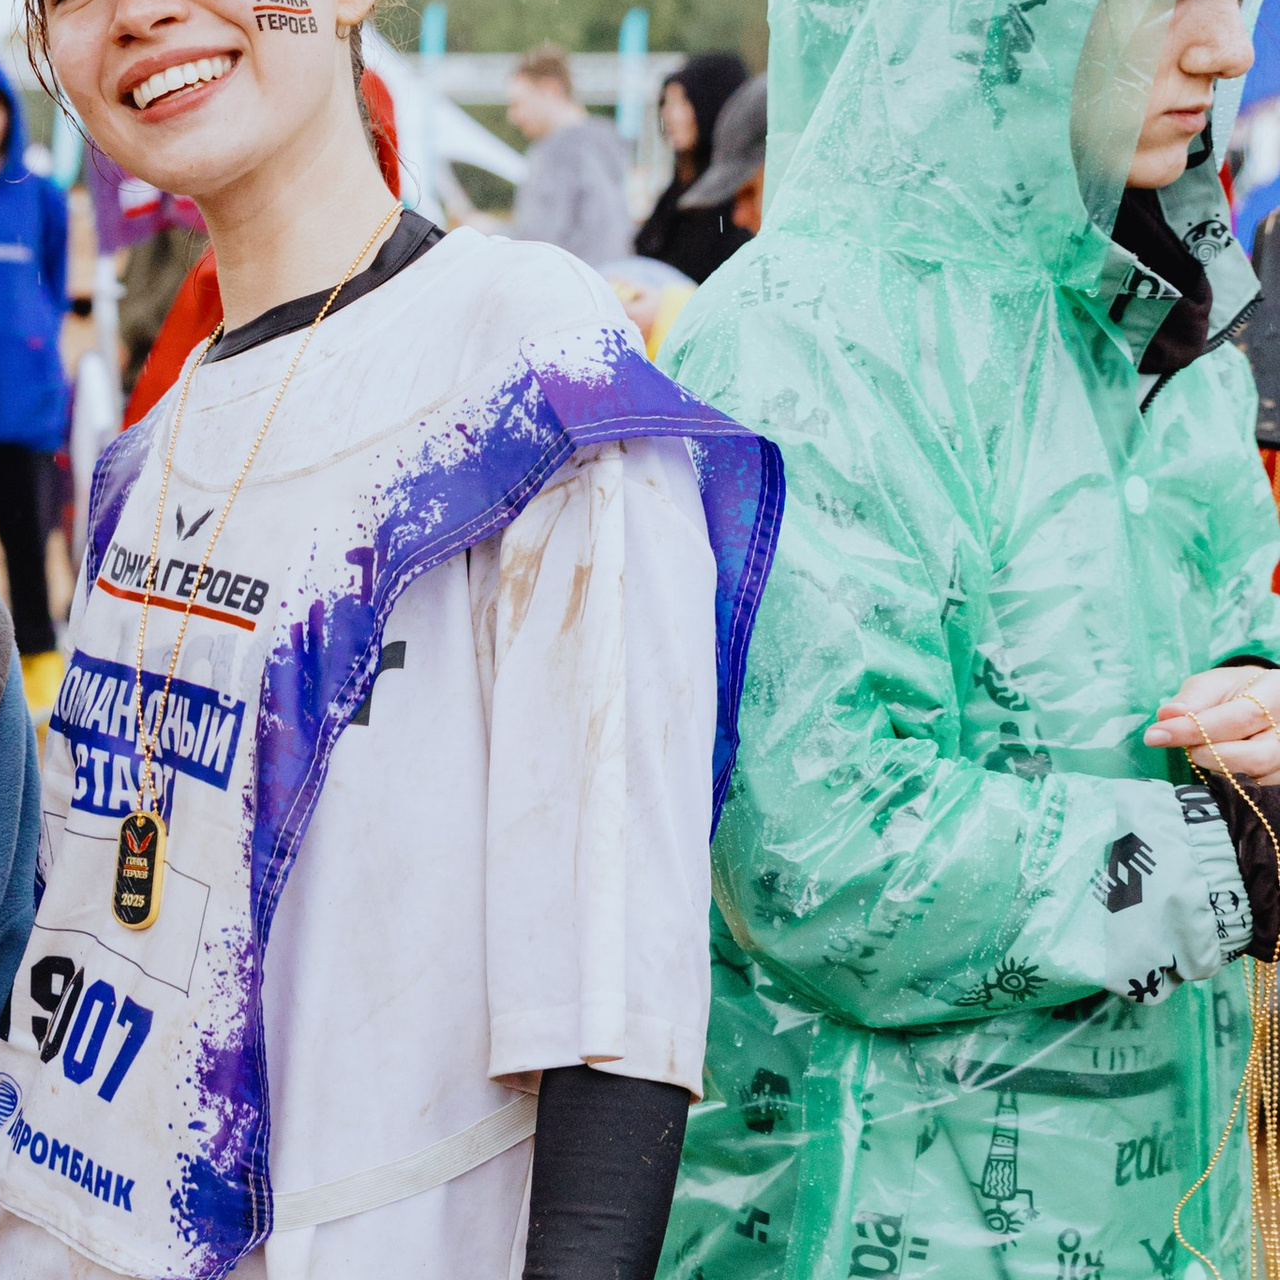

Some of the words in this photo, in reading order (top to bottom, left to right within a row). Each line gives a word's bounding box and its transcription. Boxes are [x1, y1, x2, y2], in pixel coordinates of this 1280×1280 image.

[255, 13, 318, 35] ГЕРОЕВ
[102, 541, 160, 592] ГОНКА
[160, 558, 270, 616] ГЕРОЕВ
[54, 666, 237, 774] ОМАНДНЫЙ
[126, 856, 148, 867] ГОНКА
[123, 868, 149, 879] ГЕРОЕВ
[120, 893, 146, 908] 2025
